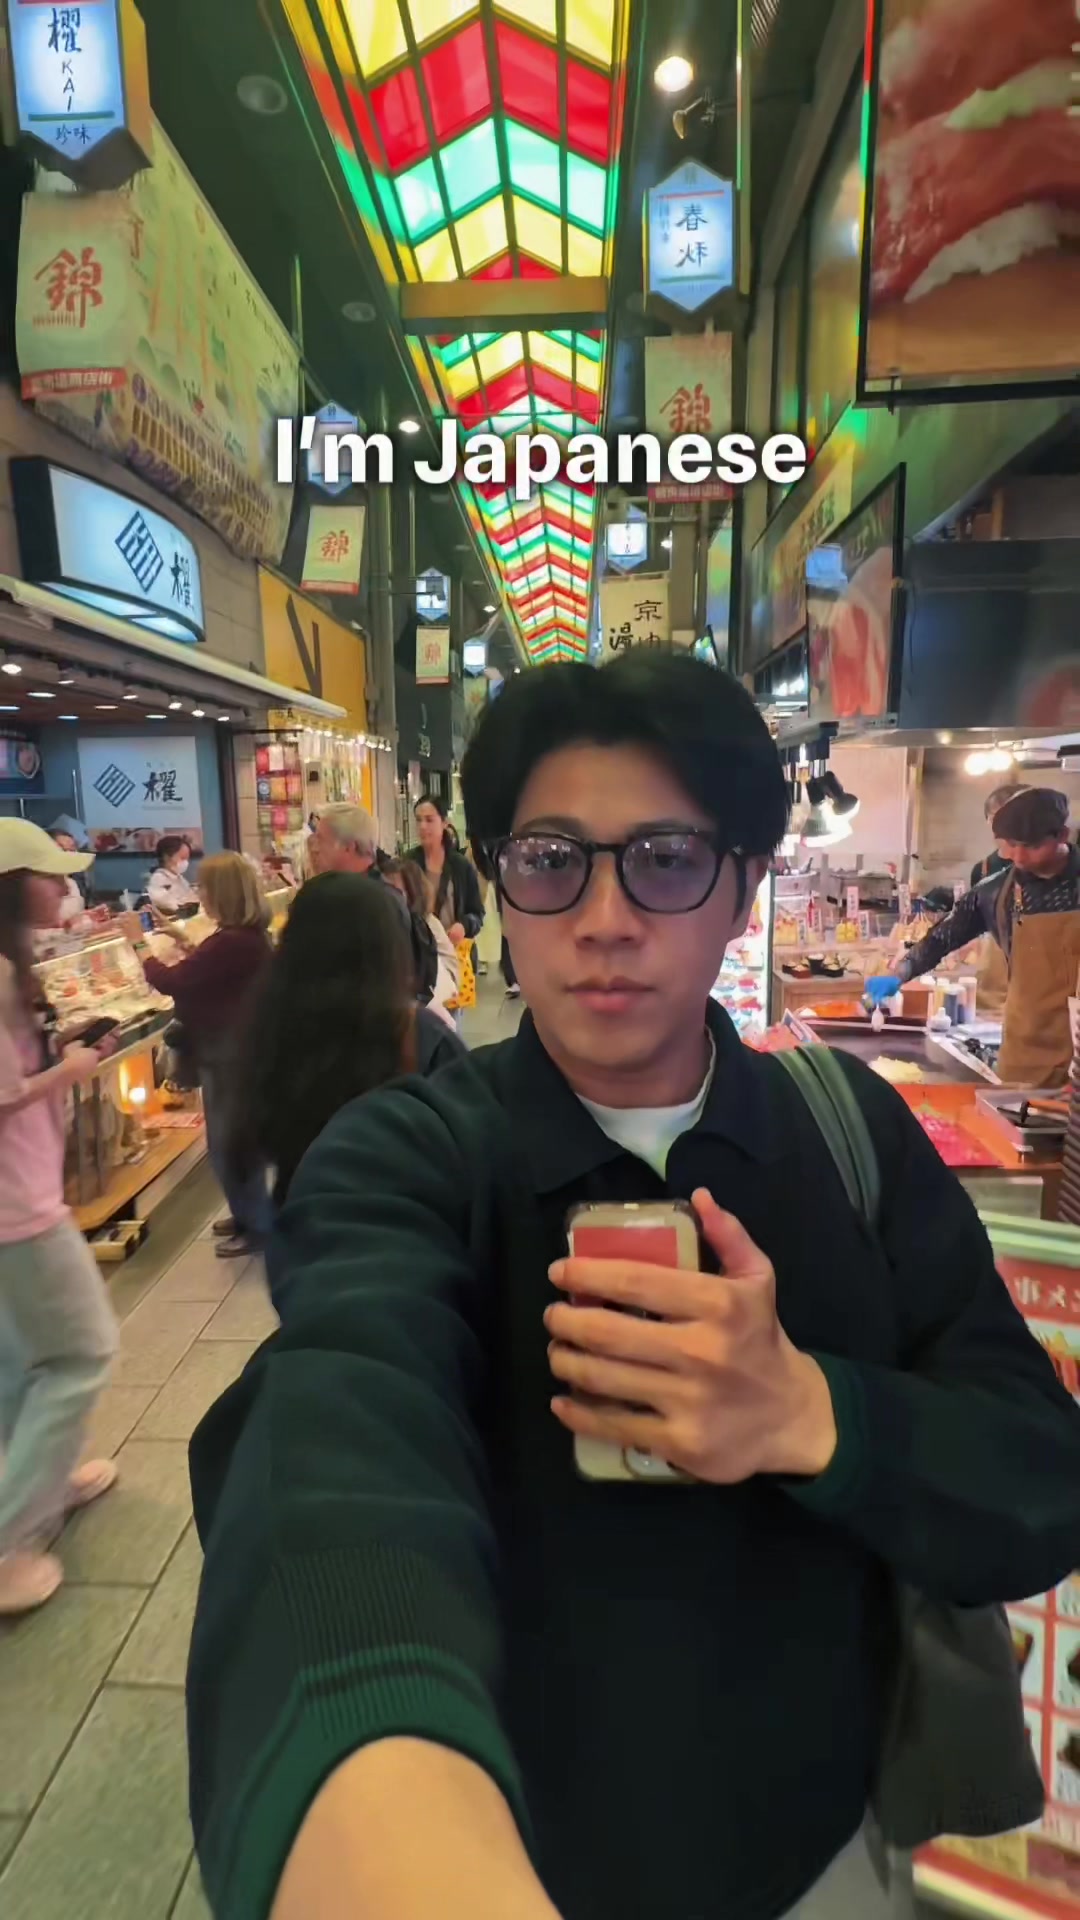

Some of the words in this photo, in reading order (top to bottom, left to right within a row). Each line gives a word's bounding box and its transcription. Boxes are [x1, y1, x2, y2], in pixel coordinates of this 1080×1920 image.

[62, 60, 75, 111] KAI
[56, 124, 90, 145] 珍味
[34, 247, 103, 328] 錦
